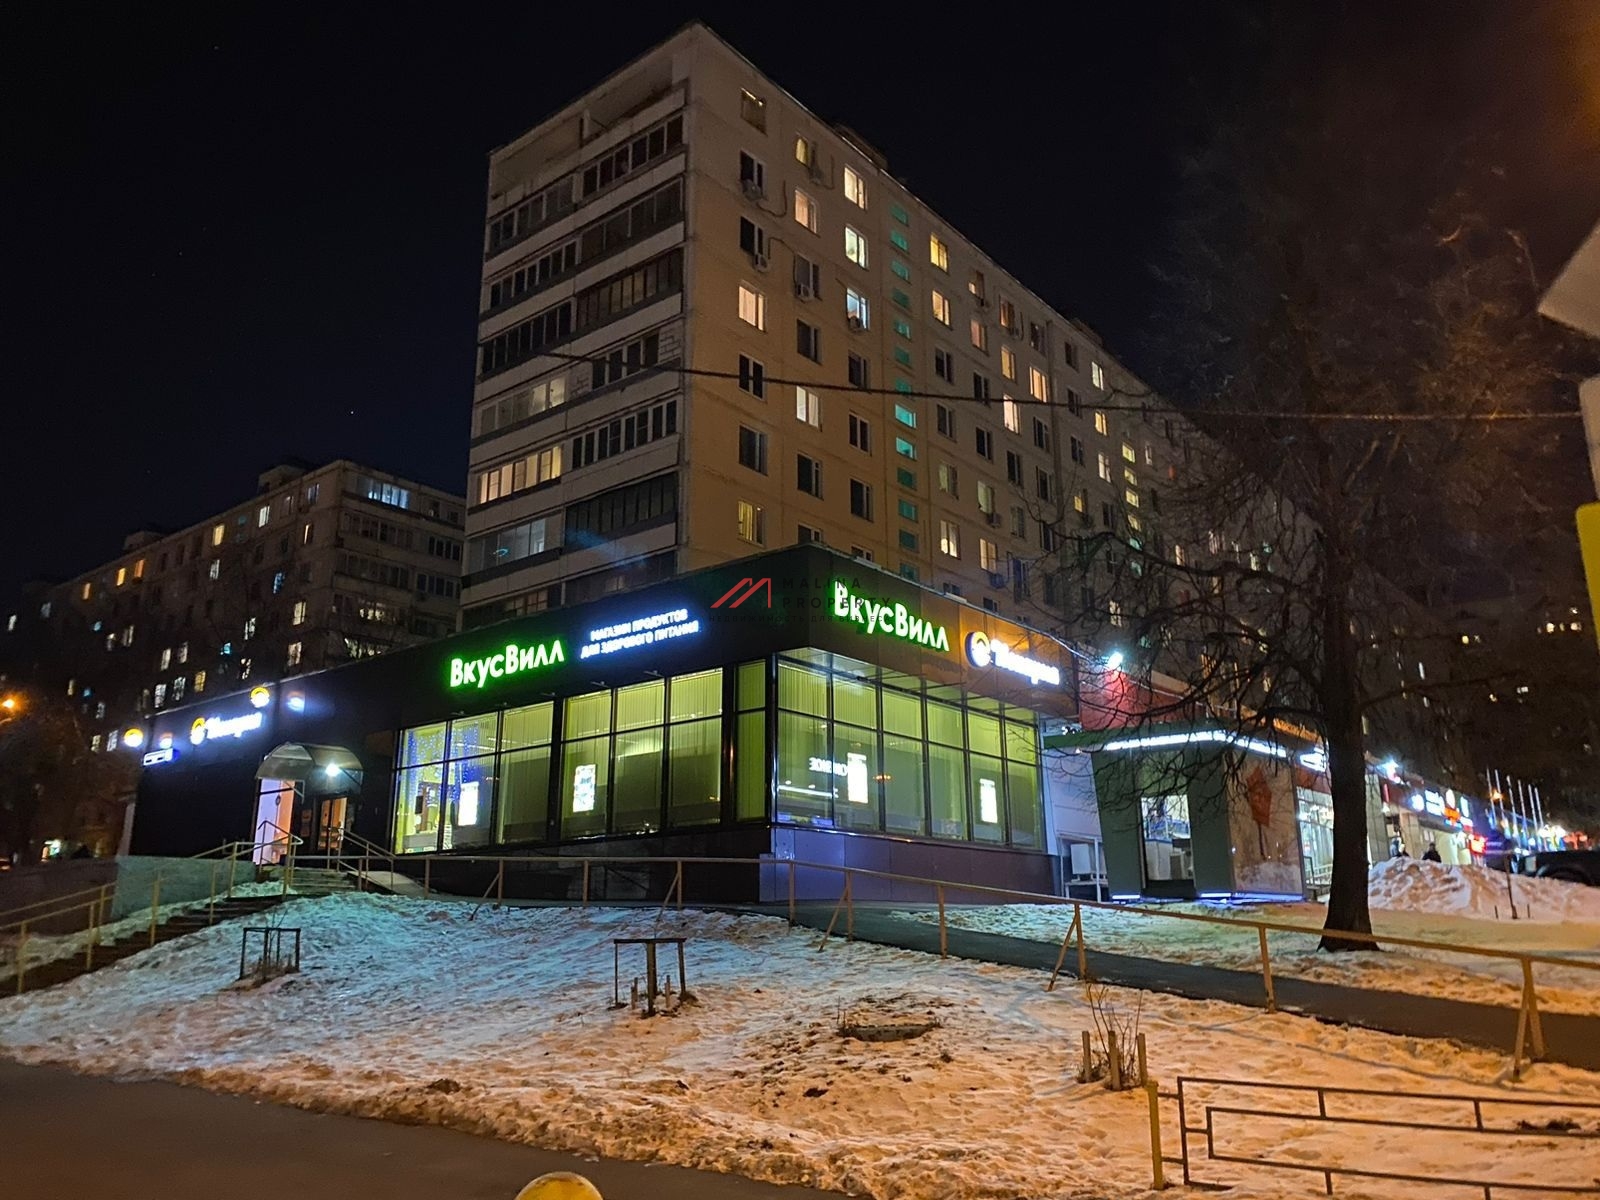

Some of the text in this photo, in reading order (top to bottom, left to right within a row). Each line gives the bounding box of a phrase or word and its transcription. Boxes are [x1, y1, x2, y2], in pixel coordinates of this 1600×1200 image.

[590, 608, 688, 642] МАГАЗИН ПРОДУКТОВ
[655, 620, 699, 641] ПИТАНИЯ
[834, 580, 950, 651] ВкусВилл
[449, 640, 565, 688] ВкусВилл
